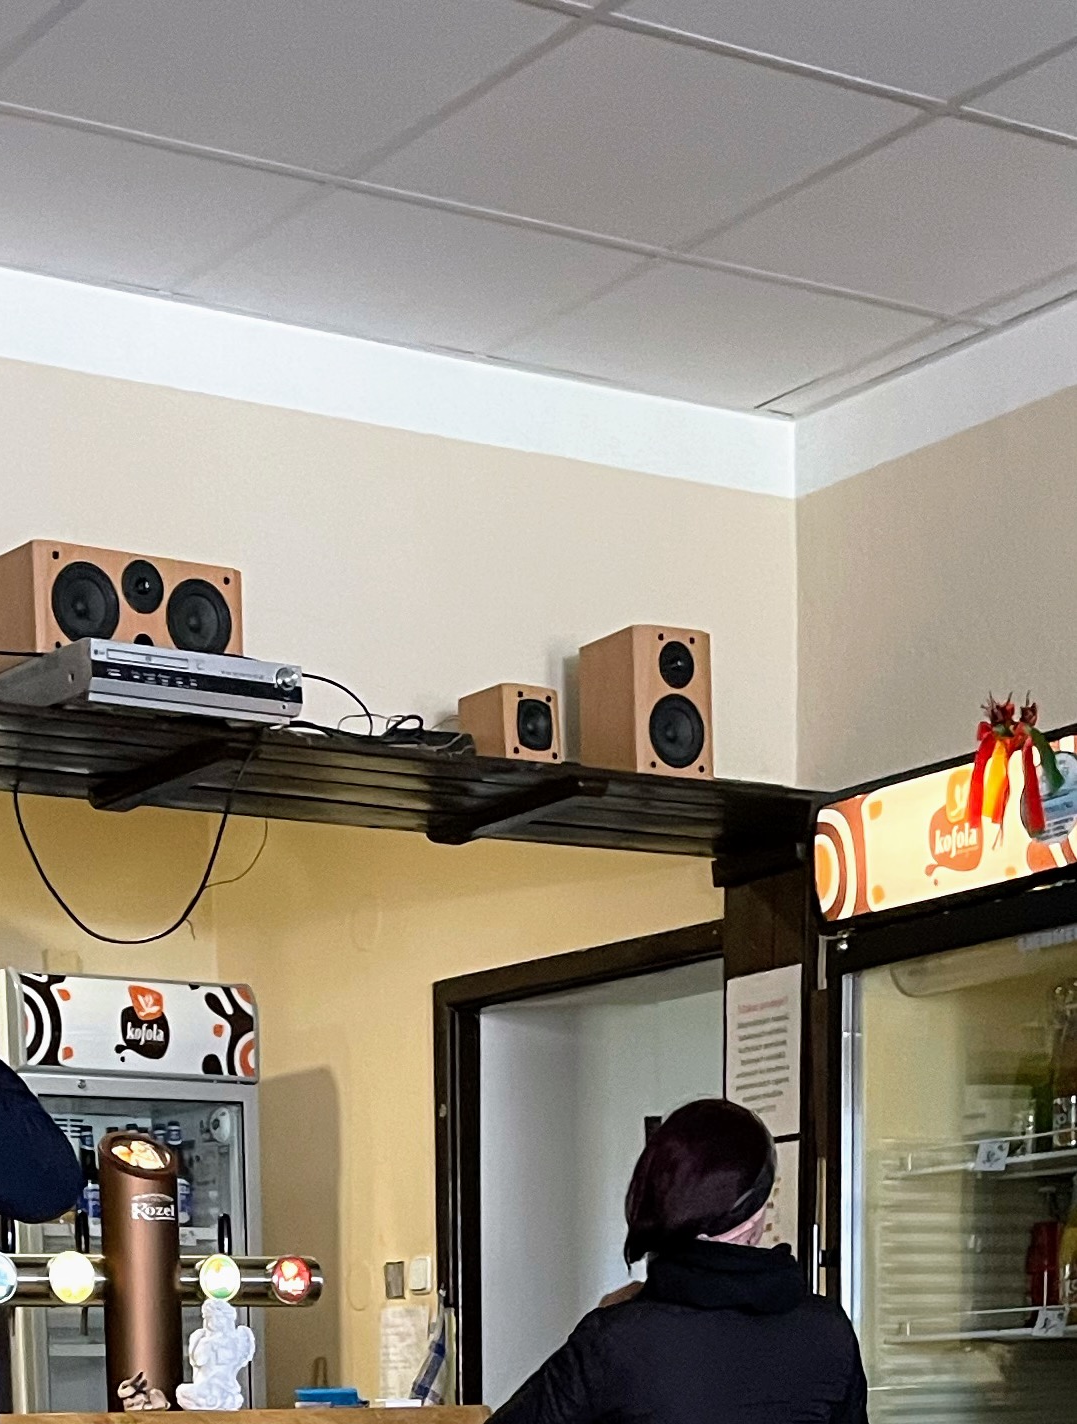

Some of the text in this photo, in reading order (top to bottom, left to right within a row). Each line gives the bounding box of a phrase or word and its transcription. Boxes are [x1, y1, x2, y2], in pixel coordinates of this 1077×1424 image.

[935, 822, 979, 858] kofola
[126, 1021, 164, 1046] kofola
[131, 1202, 175, 1221] Kozel
